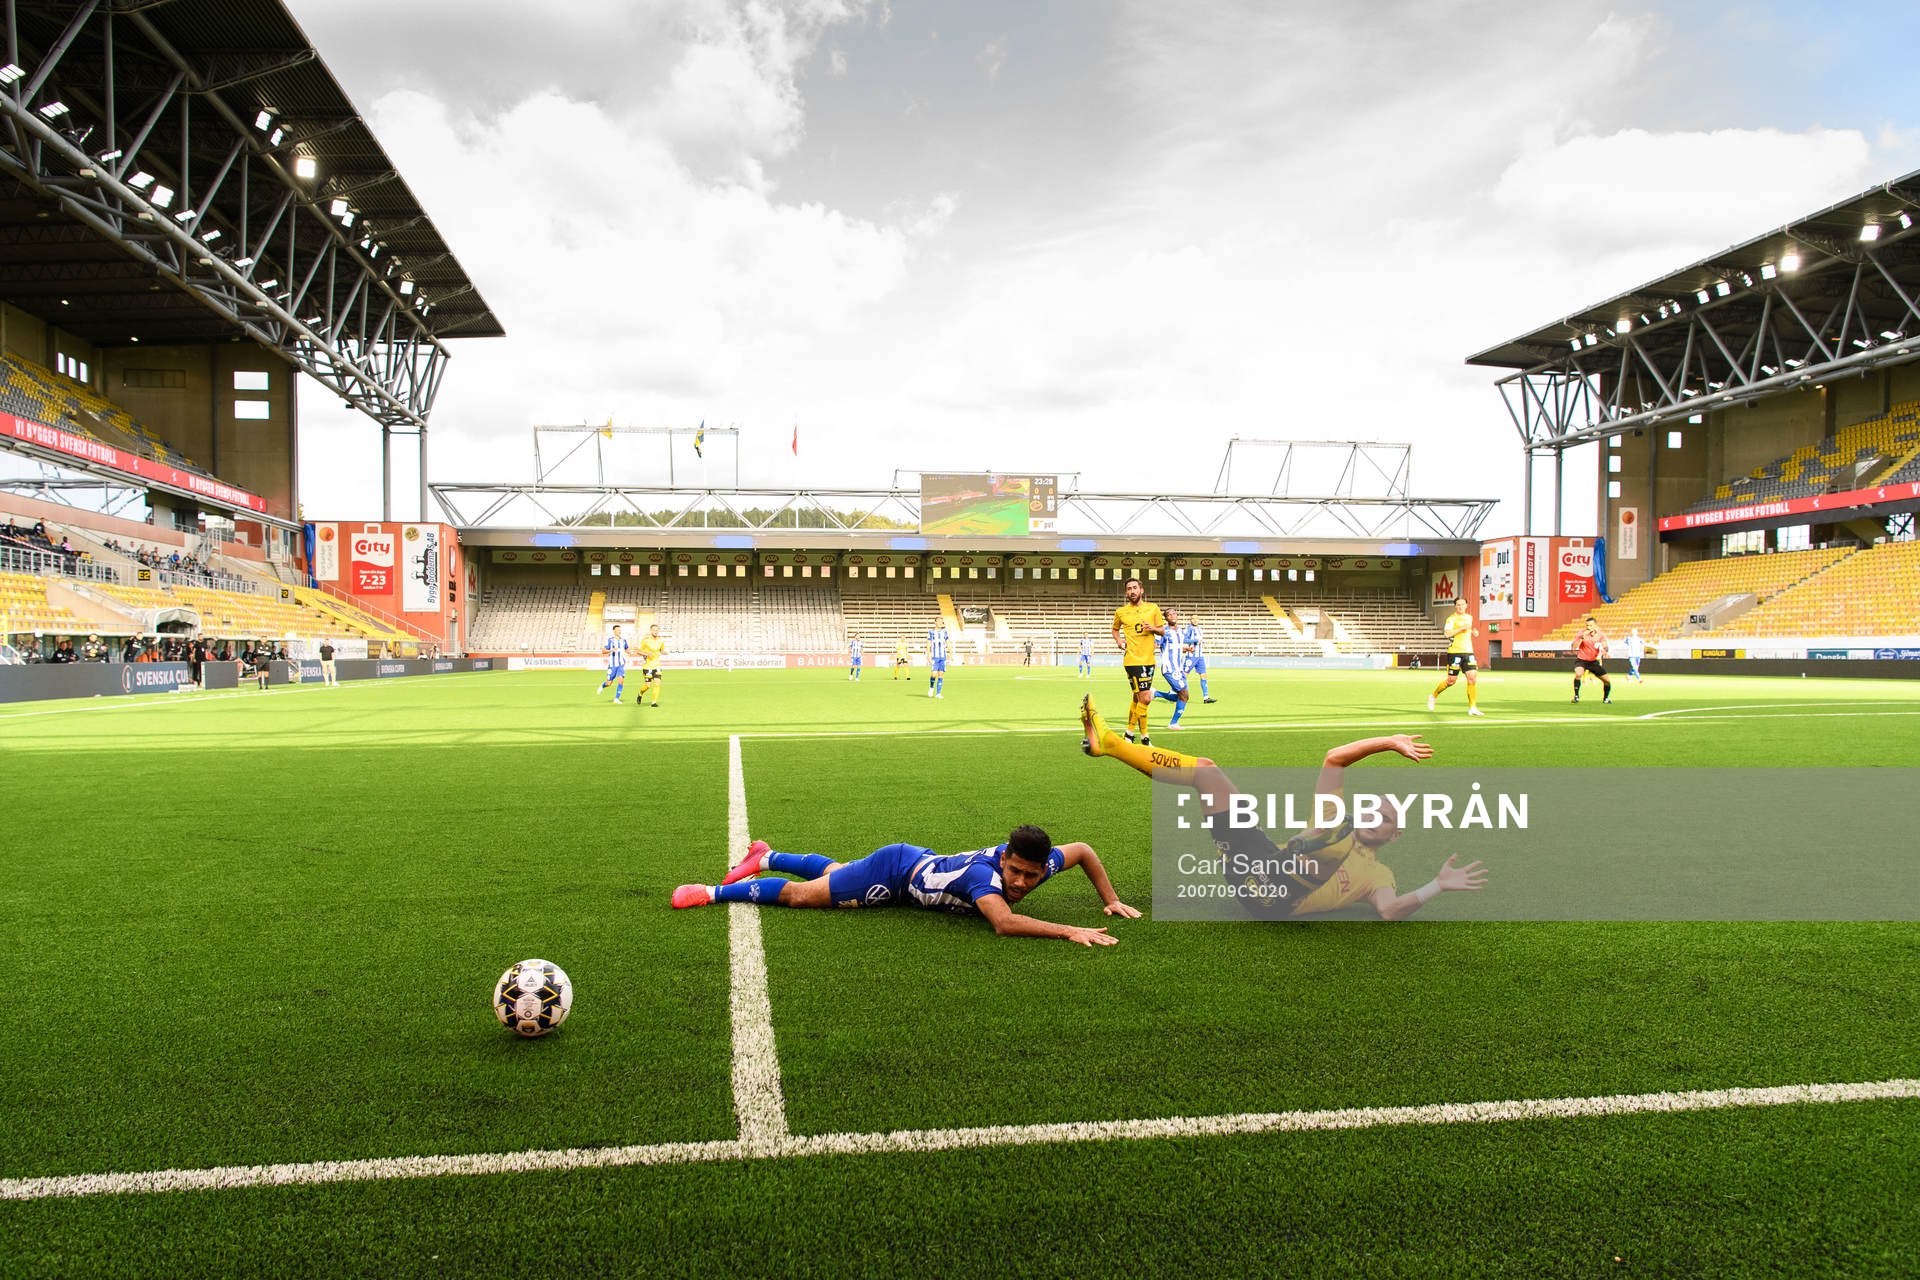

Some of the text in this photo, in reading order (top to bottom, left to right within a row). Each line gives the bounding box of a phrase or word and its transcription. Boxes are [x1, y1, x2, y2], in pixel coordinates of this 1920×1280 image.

[15, 419, 117, 464] VI BYGGER SVENSK FOTBOLL
[1686, 502, 1790, 526] VI BYGGER SVENSK FOTBOLL
[355, 540, 390, 555] City
[1497, 548, 1509, 568] put
[1562, 552, 1591, 566] City
[138, 571, 150, 580] E2
[360, 575, 386, 585] 7-23
[1564, 585, 1587, 594] 7-23
[135, 670, 174, 686] SVENSKA
